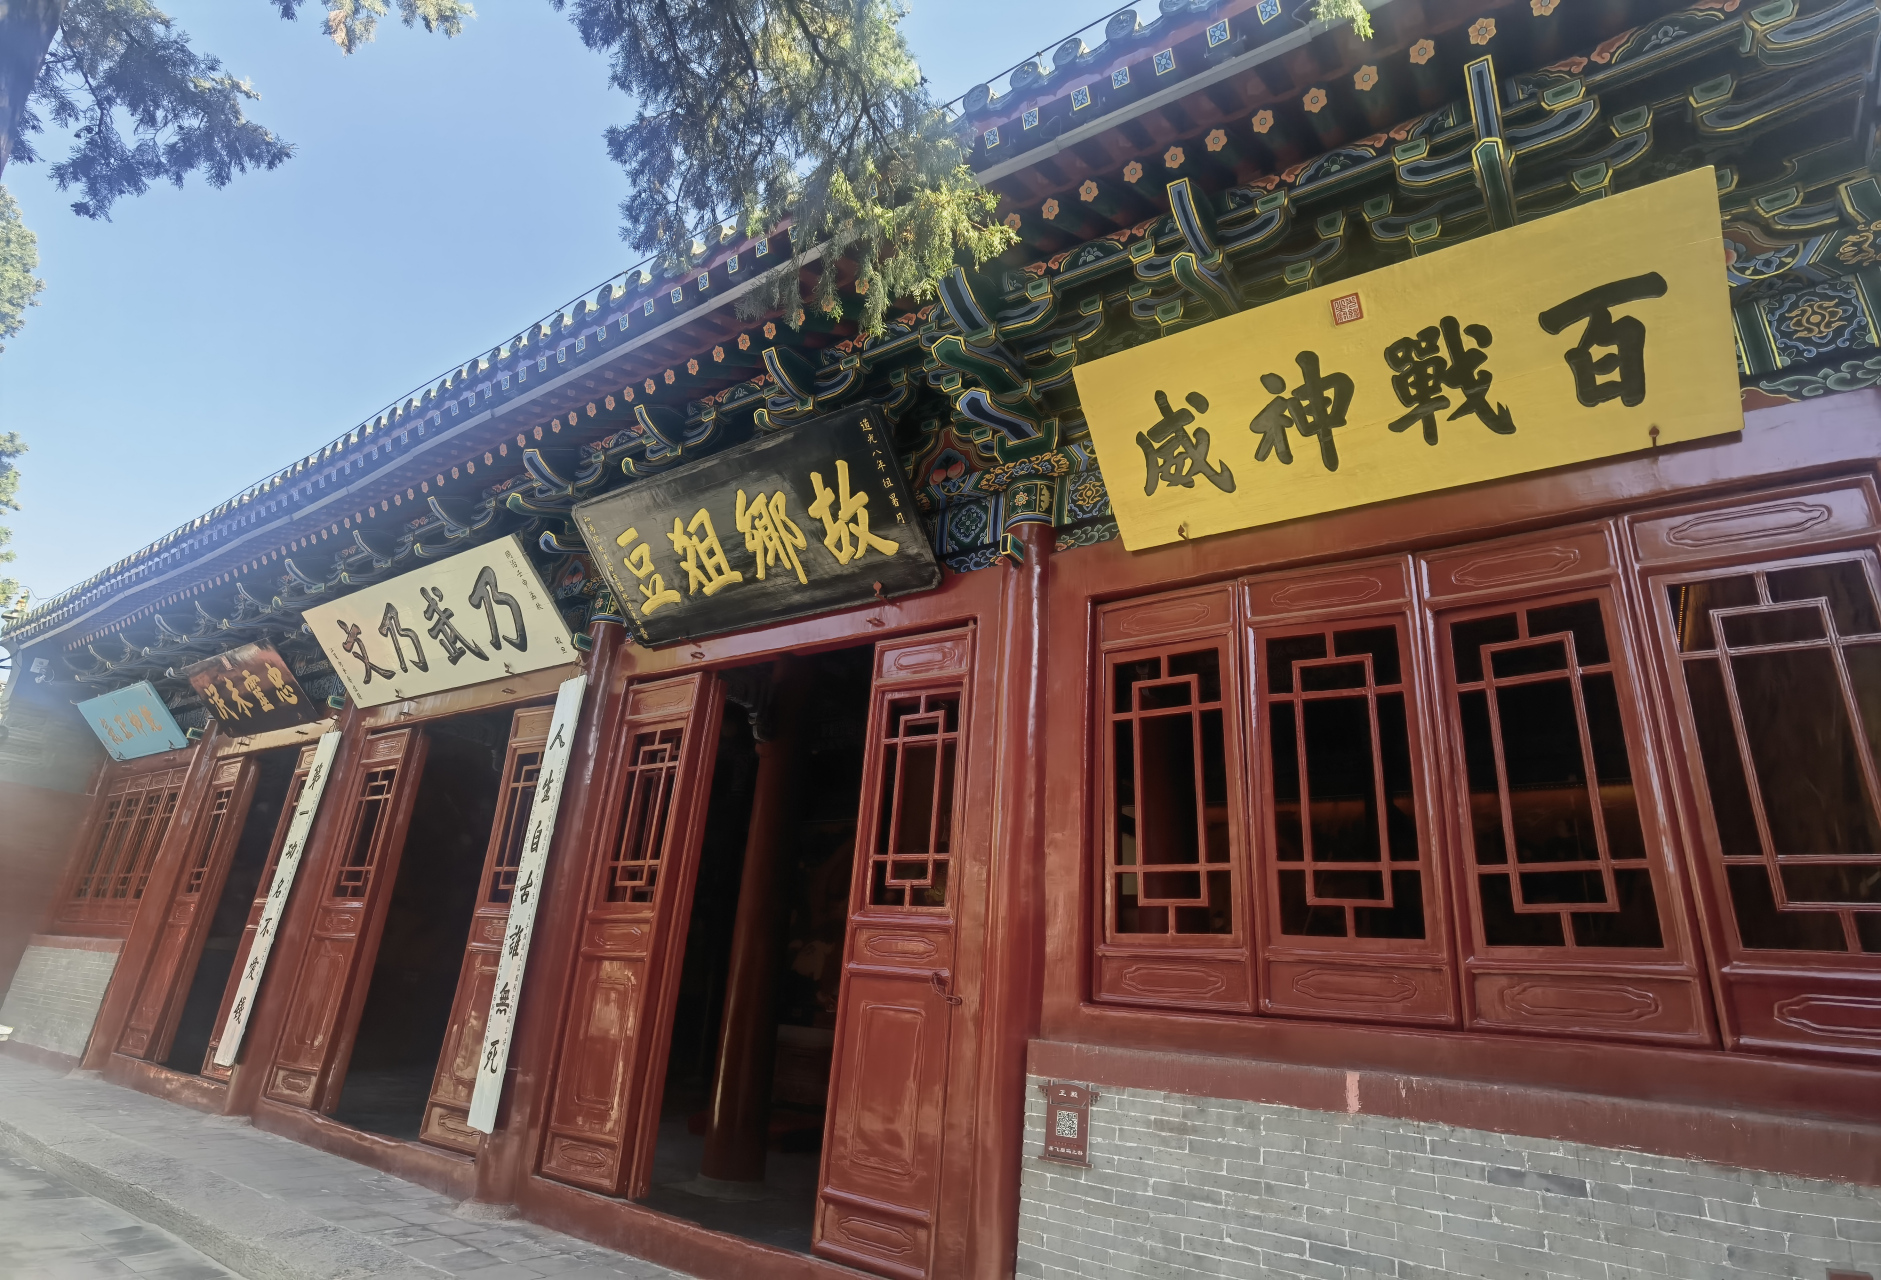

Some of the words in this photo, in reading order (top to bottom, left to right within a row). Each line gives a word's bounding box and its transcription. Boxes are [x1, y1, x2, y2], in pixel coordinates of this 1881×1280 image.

[1135, 271, 1668, 494] 百戰神威
[337, 566, 528, 685] 乃武乃文
[616, 459, 899, 616] 故鄉俎豆
[203, 662, 298, 720] 忠靈未泯
[233, 762, 324, 1025] 第一功名不愛錢
[483, 723, 565, 1074] 人生自古誰無死
